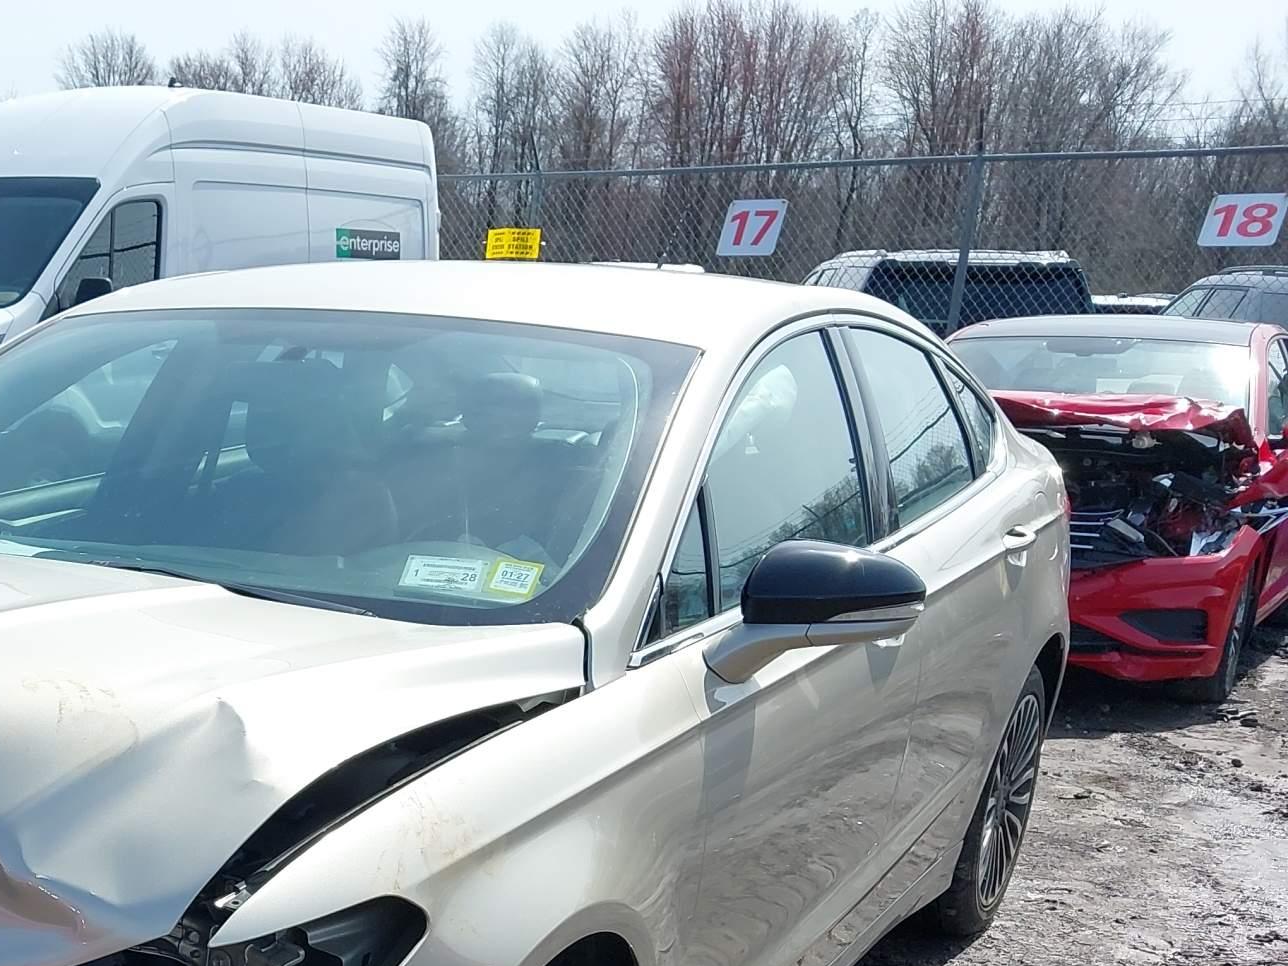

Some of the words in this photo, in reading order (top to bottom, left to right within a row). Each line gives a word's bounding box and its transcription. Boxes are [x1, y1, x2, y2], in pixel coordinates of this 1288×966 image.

[730, 210, 779, 246] 17
[1213, 203, 1278, 238] 18
[337, 235, 400, 256] enterprise
[461, 572, 478, 582] 28
